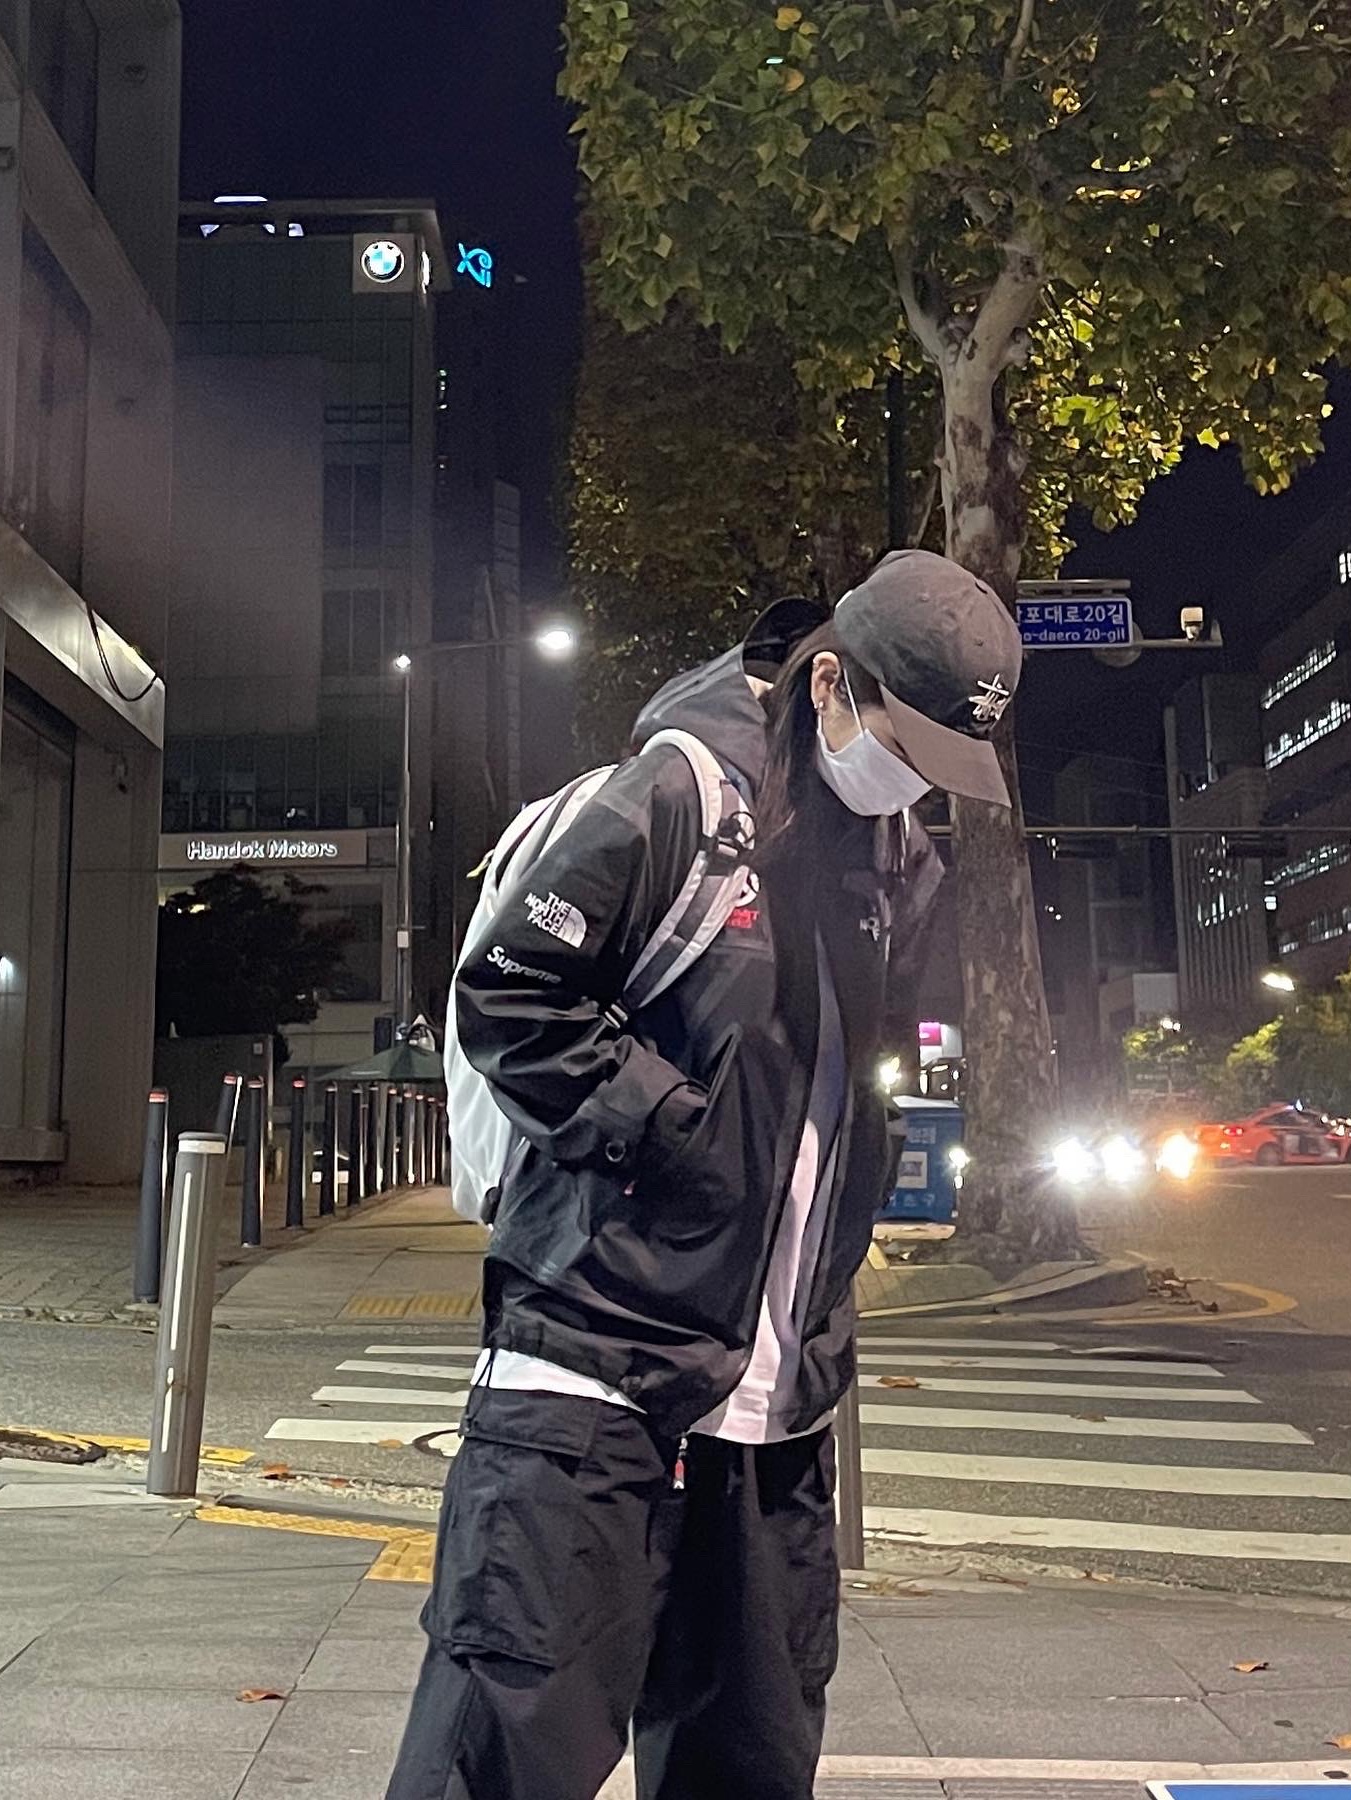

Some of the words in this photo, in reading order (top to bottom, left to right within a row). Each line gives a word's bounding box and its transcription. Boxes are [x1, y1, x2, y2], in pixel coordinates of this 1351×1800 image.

[1020, 628, 1080, 642] o-daero
[1083, 627, 1126, 643] 20-gil
[187, 840, 265, 860] Handok
[267, 839, 338, 858] Motors
[524, 892, 565, 925] NORTH
[545, 891, 573, 916] THE
[527, 909, 561, 936] FACE
[486, 945, 562, 984] Supreme
